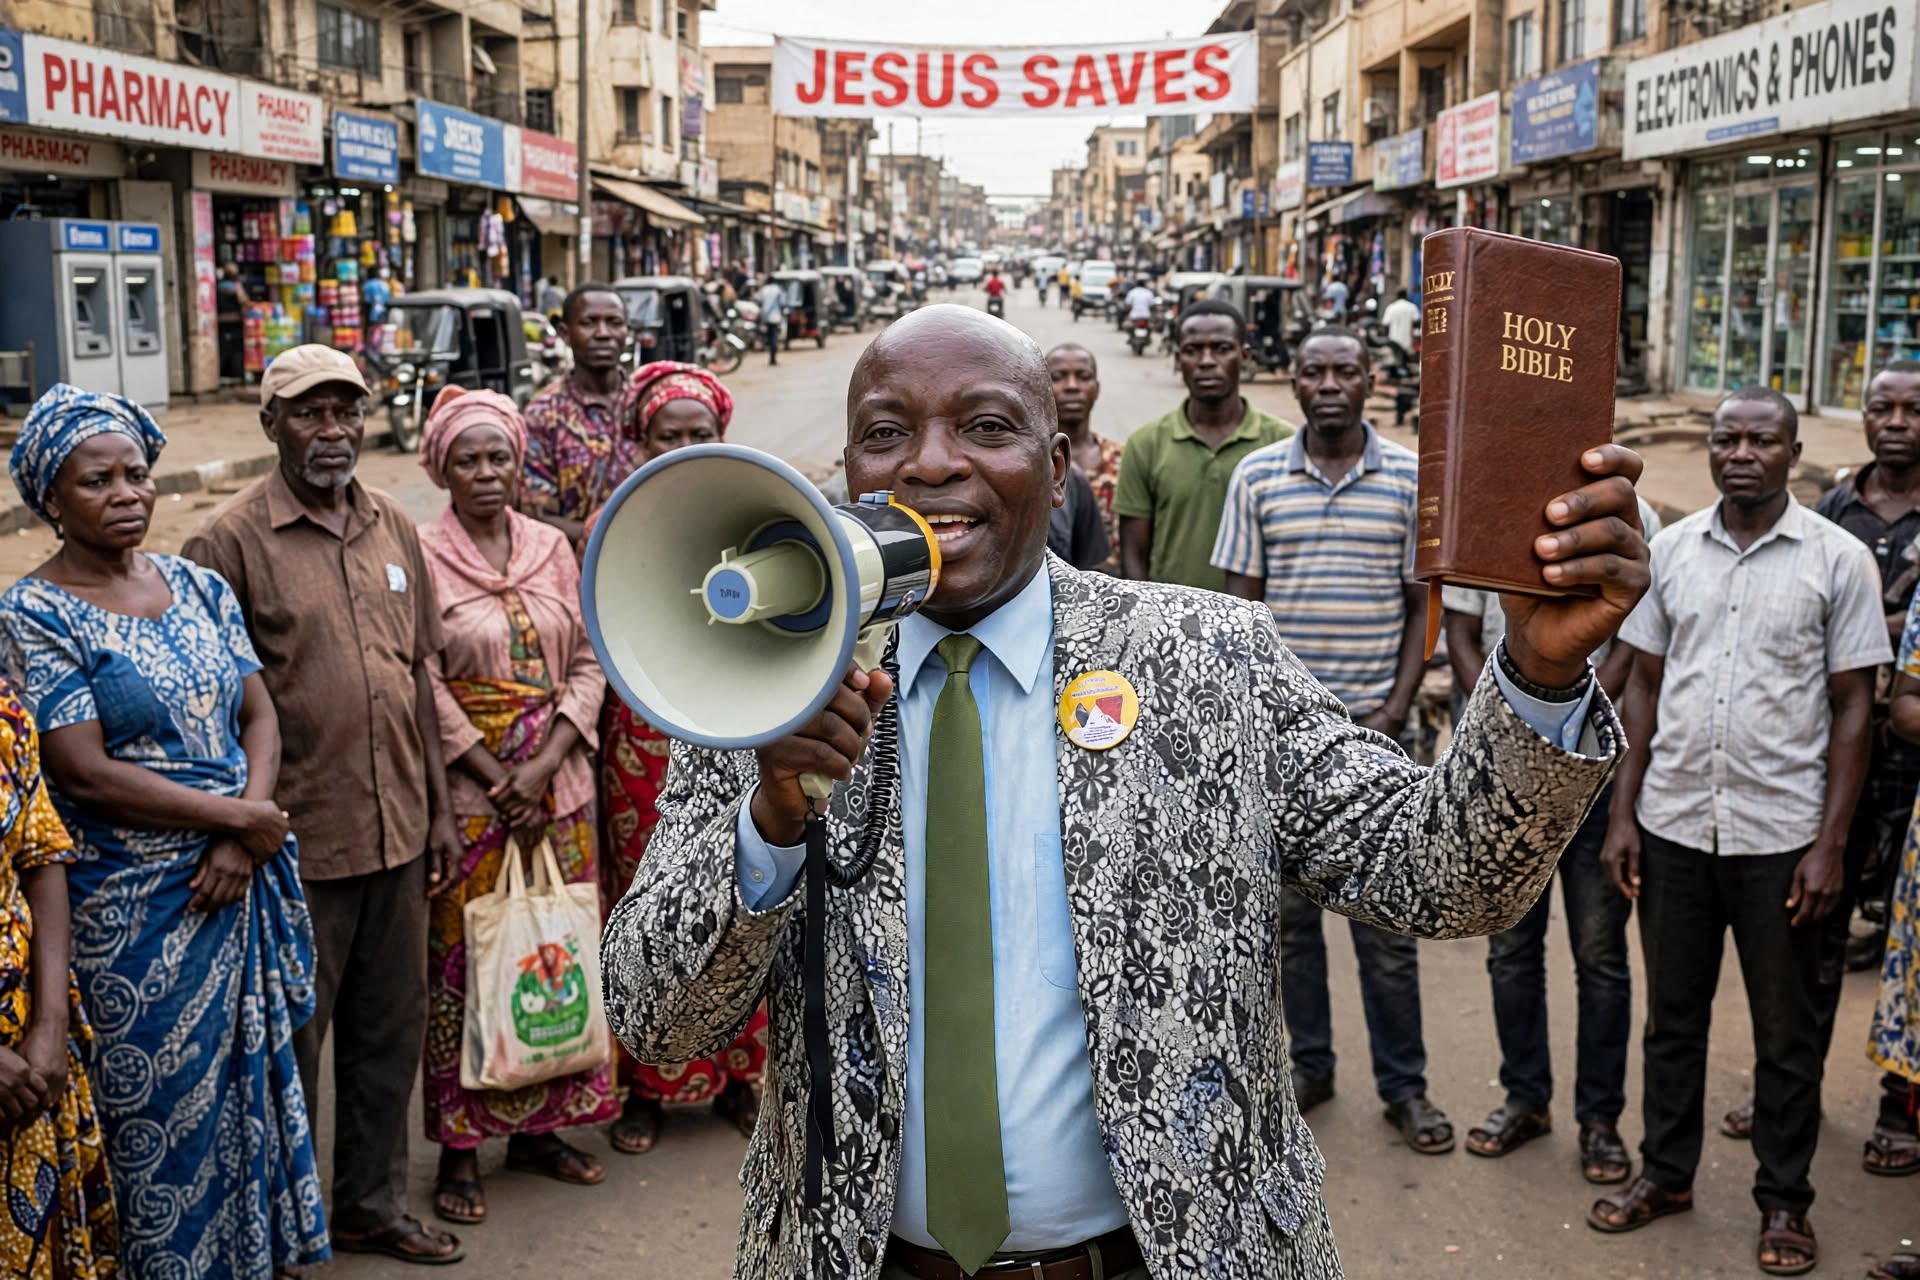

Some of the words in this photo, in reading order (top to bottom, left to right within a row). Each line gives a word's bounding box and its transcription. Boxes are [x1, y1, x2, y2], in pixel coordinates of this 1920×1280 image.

[796, 48, 1000, 109] JESUS
[1022, 44, 1232, 108] SAVES
[1636, 48, 1760, 134] ELECTRONICS
[1767, 42, 1781, 106] &
[1790, 6, 1897, 101] PHONES
[43, 52, 230, 137] PHARMACY
[1, 135, 91, 165] PHARMACY
[209, 154, 289, 187] PHARMACY
[1502, 311, 1577, 351] HOLY
[1500, 344, 1574, 382] BIBLE
